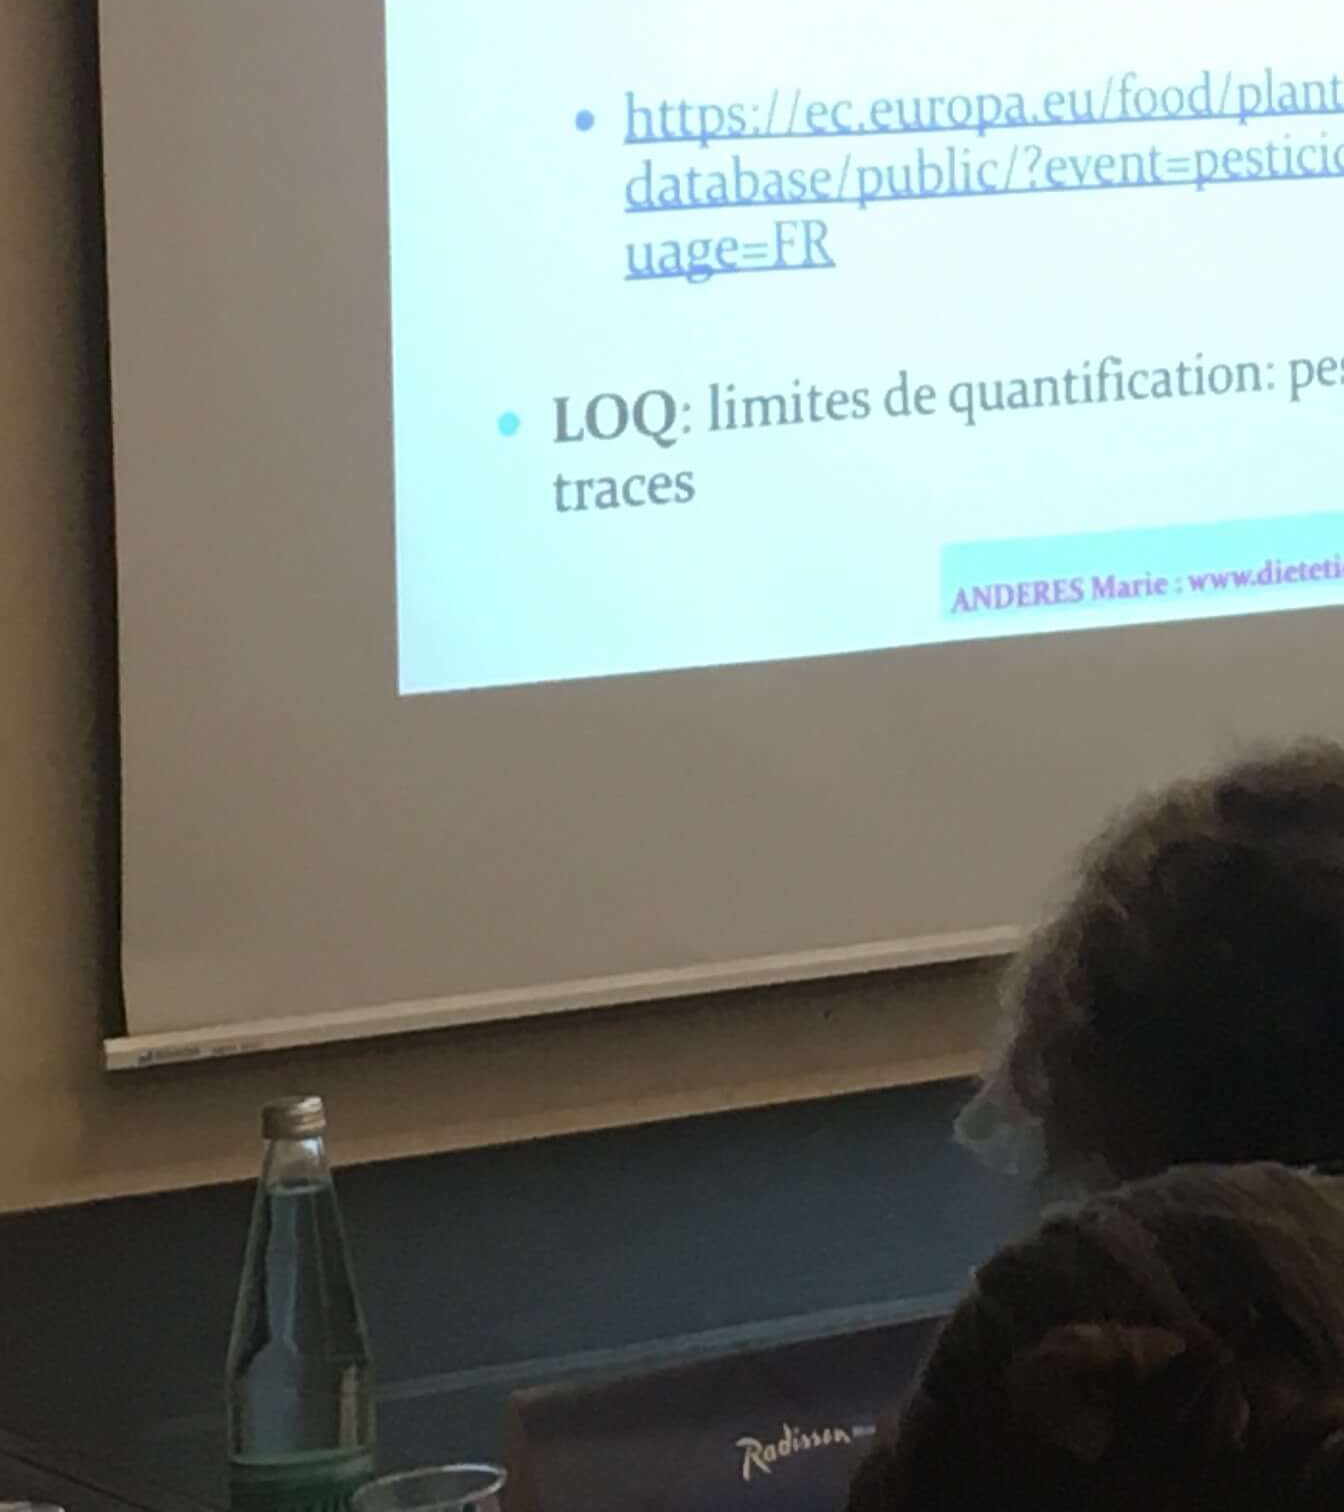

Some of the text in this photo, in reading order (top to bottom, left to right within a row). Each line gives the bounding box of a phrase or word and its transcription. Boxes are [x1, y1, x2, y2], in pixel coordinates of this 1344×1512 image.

[625, 218, 834, 282] uage=FR
[553, 390, 690, 448] LOQ:
[709, 379, 871, 431] limites
[884, 370, 936, 417] de
[949, 352, 1274, 426] quantification:
[553, 472, 695, 512] traces
[951, 578, 1084, 613] ANDERES
[1092, 573, 1168, 601] Marie
[1175, 578, 1182, 593] :
[735, 1423, 851, 1481] Radisson
